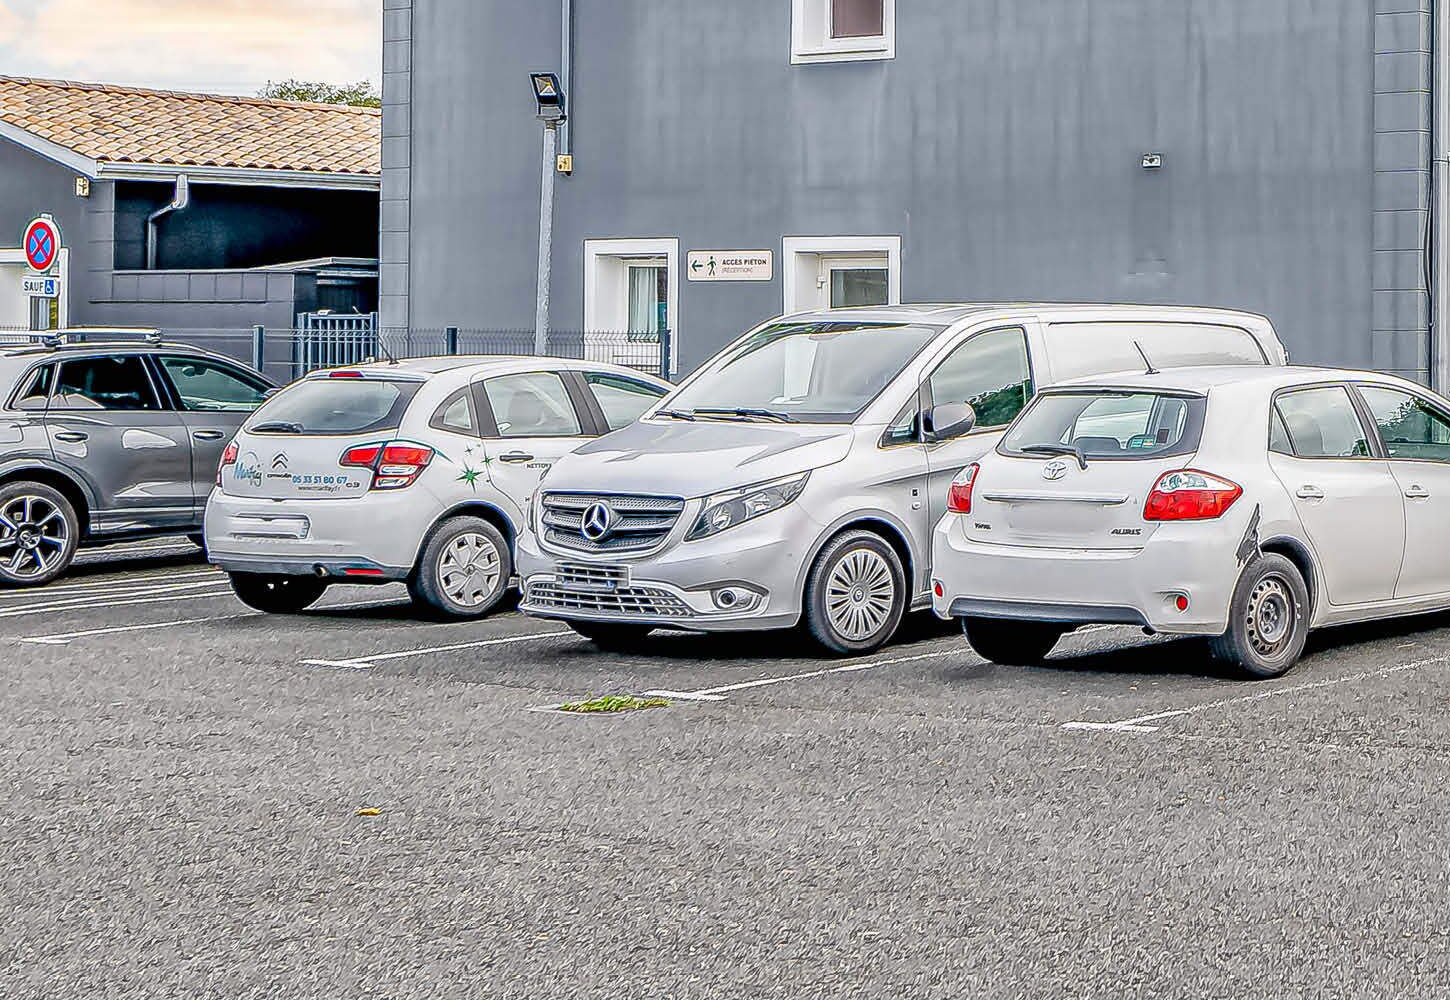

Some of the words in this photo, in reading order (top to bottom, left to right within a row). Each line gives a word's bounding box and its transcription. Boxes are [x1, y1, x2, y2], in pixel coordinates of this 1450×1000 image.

[23, 280, 44, 292] SAUF
[303, 474, 313, 484] 33
[313, 474, 322, 484] 51
[336, 475, 348, 485] 67
[1110, 527, 1142, 536] AURIS
